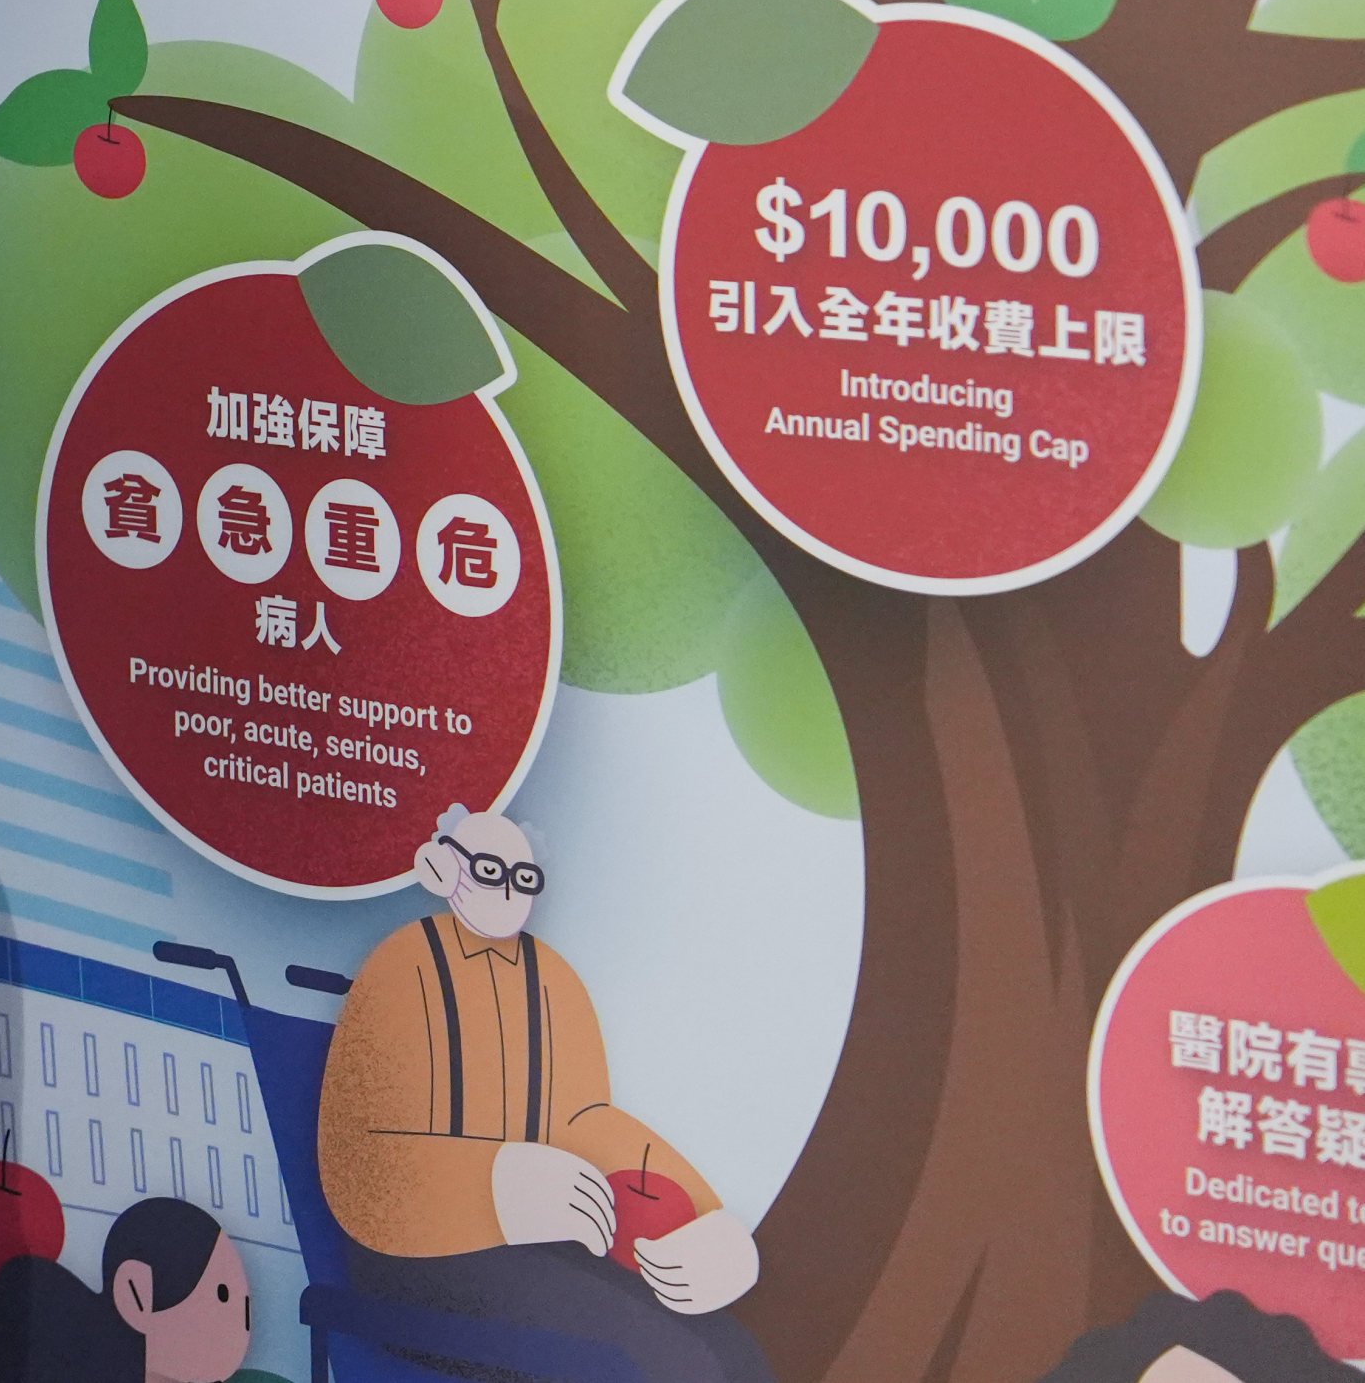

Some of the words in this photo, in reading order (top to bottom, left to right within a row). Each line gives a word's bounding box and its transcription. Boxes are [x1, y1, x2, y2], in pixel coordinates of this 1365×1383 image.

[754, 176, 1100, 281] $10,000
[707, 278, 1146, 368] 引入全年收費上限
[206, 386, 387, 460] 加強保障
[840, 368, 1014, 418] Introducing
[764, 407, 870, 442] Annual
[878, 417, 1021, 462] Spending
[1028, 428, 1089, 468] Cap
[103, 472, 499, 591] 貧急重危
[255, 595, 342, 655] 病人
[128, 657, 251, 705] Providing
[258, 675, 332, 714] better
[337, 691, 439, 735] support
[444, 706, 472, 736] to
[174, 707, 238, 744] poor,
[243, 716, 319, 758] acute,
[325, 733, 427, 777] serious,
[203, 753, 289, 789] critical
[296, 768, 397, 810] patients
[1197, 1085, 1365, 1171] 解答疑
[1185, 1166, 1339, 1221] Dedicated
[1159, 1208, 1191, 1238] to
[1199, 1218, 1311, 1259] answer
